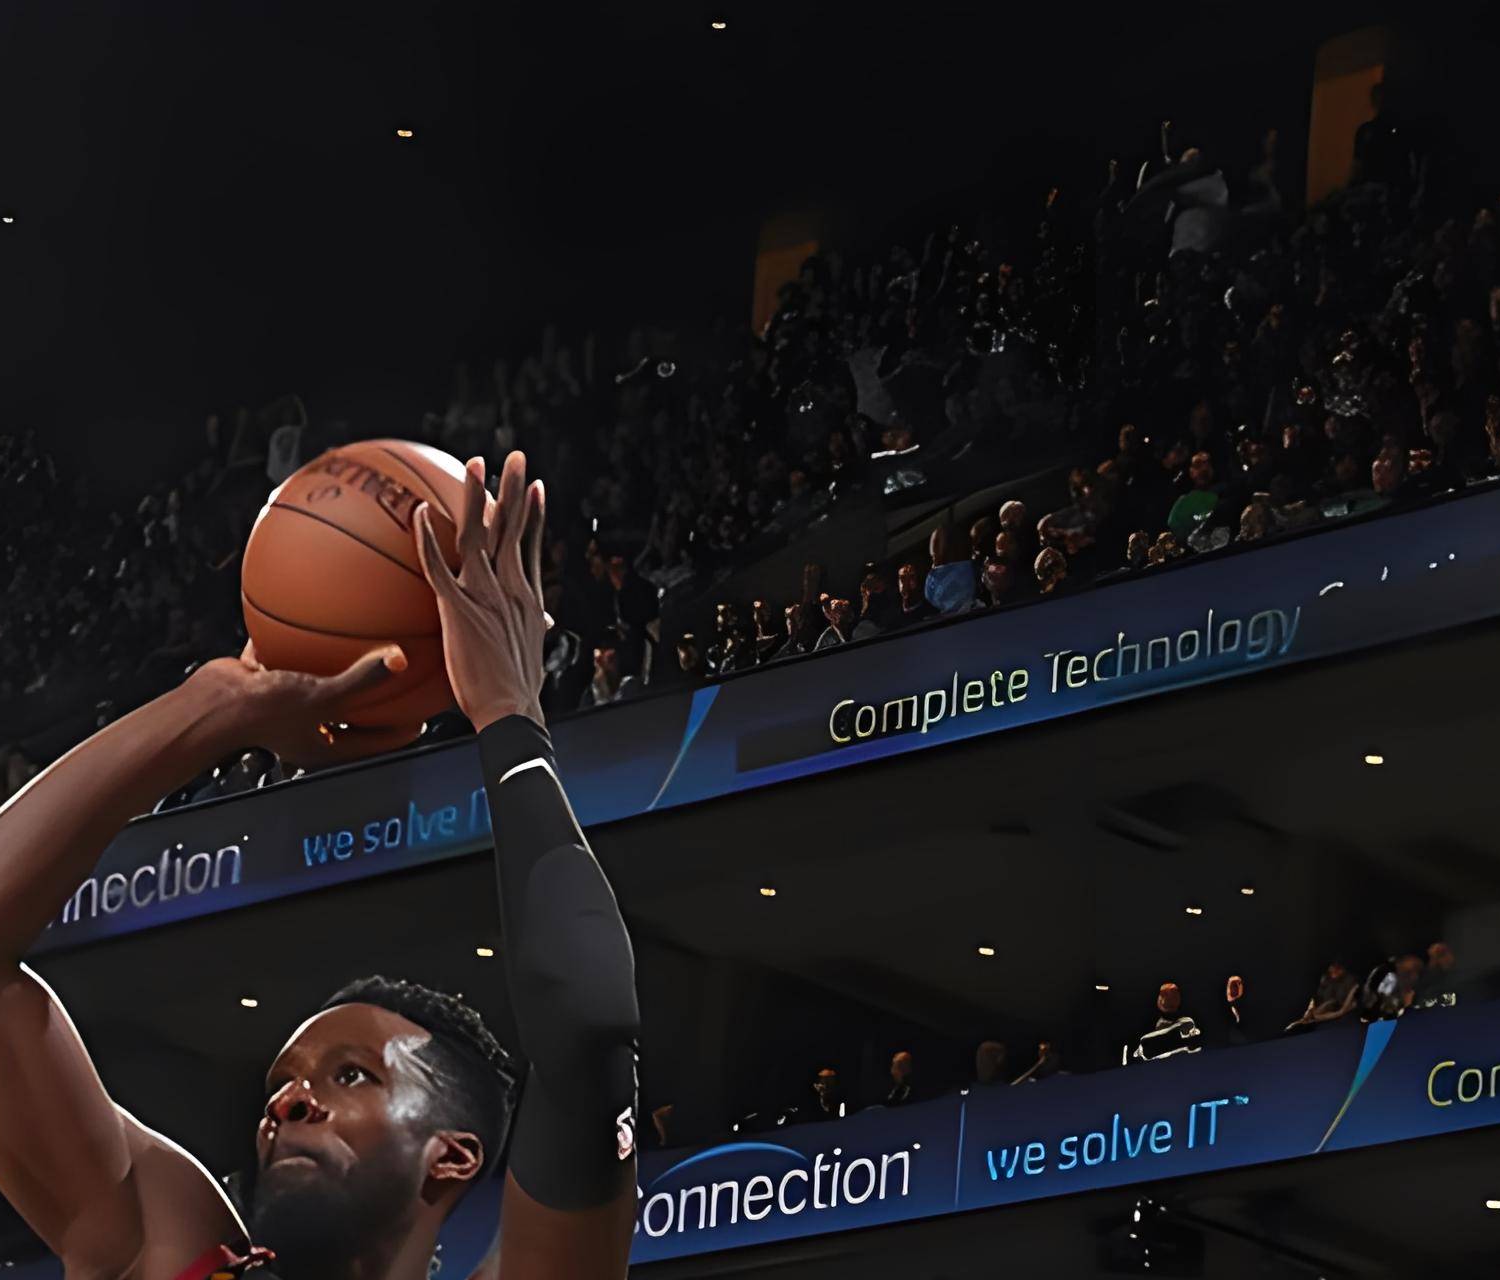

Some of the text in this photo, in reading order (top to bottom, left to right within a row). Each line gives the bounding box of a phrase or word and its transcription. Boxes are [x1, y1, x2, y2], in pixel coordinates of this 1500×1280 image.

[828, 606, 1301, 743] Complete Technology
[302, 830, 354, 867] we
[363, 800, 458, 854] solve
[986, 1142, 1047, 1182] we
[1057, 1113, 1173, 1171] solve
[634, 1147, 911, 1238] onnection
